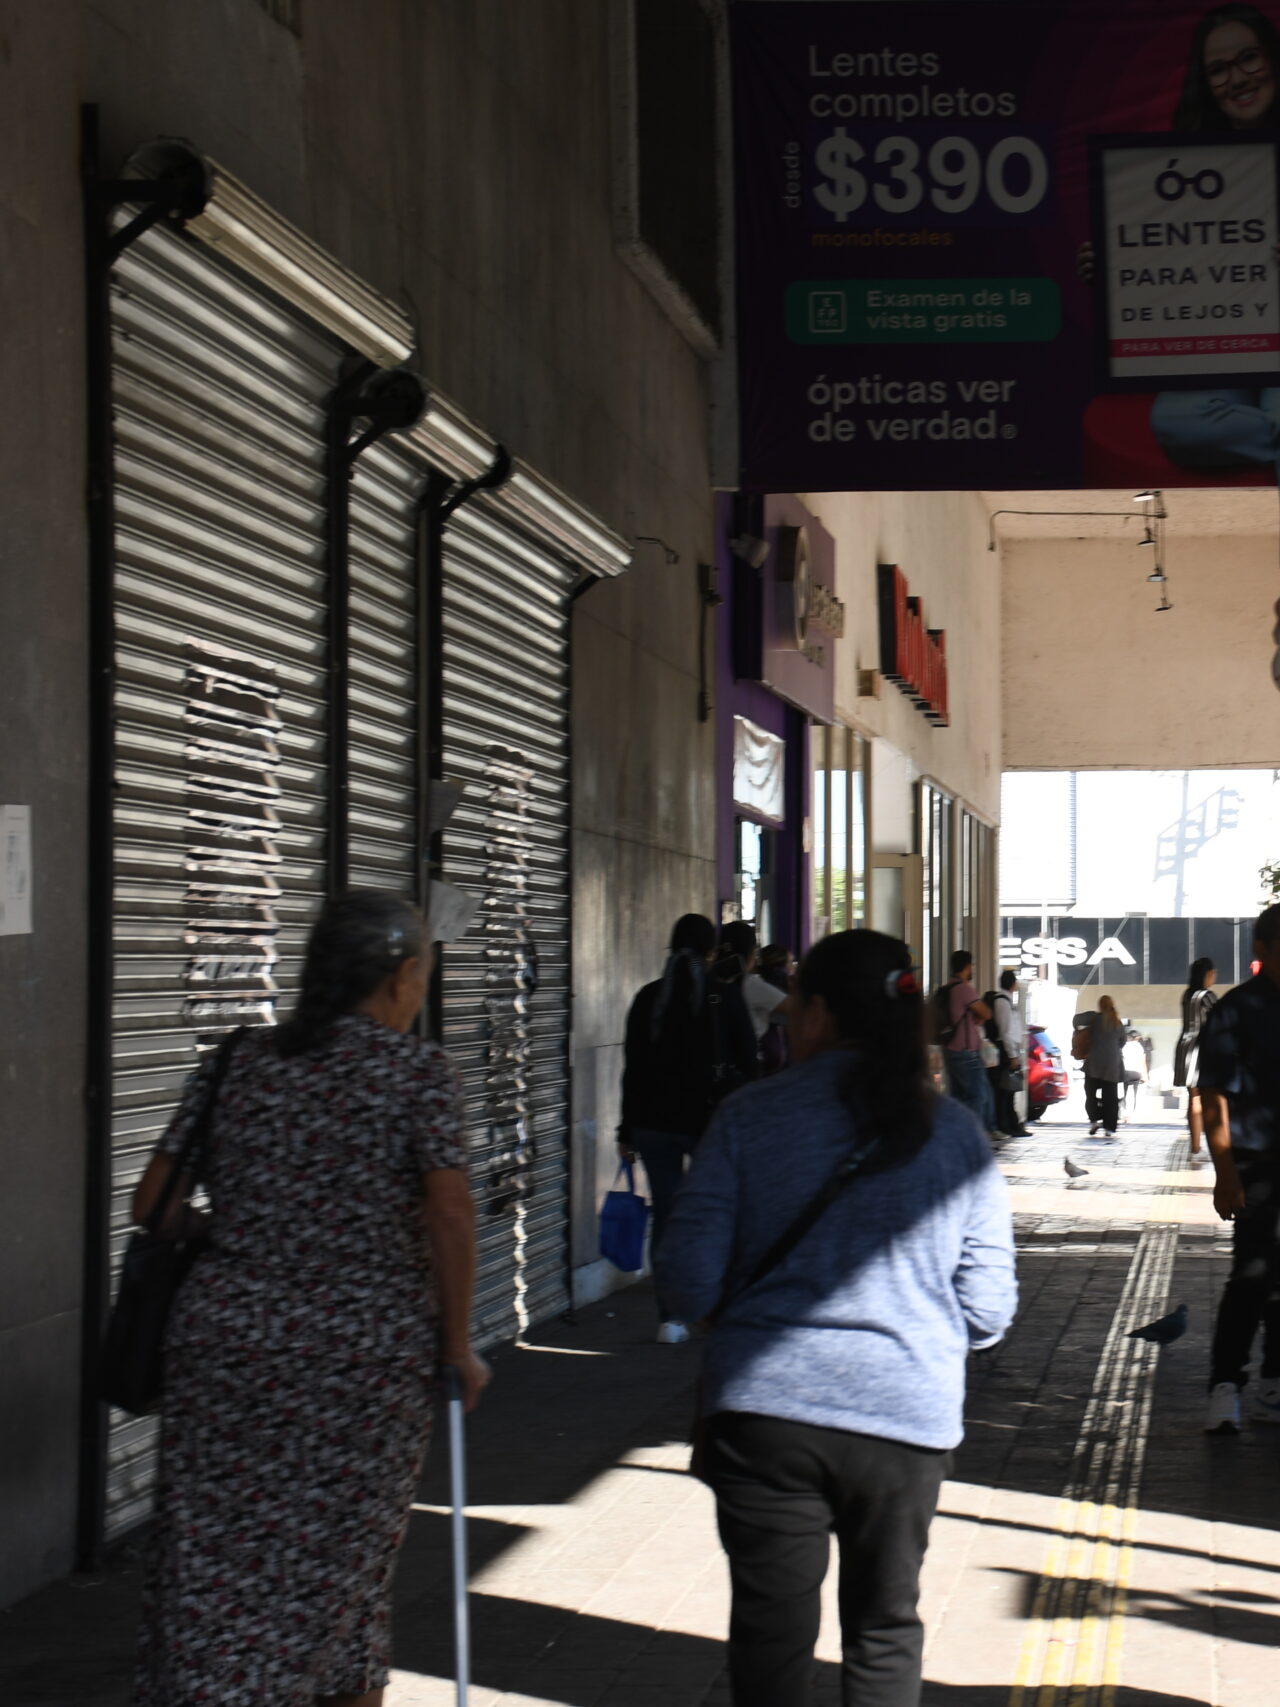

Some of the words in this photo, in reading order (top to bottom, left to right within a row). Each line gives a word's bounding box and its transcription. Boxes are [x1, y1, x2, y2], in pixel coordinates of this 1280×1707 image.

[808, 45, 940, 78] Lentes
[808, 85, 1017, 123] completos
[812, 126, 1049, 222] $390
[811, 229, 954, 247] monofocales
[1118, 219, 1266, 248] LENTES
[1120, 267, 1198, 287] PARA
[1208, 264, 1268, 283] VER
[867, 290, 966, 308] Examen
[973, 288, 1002, 307] de
[1009, 288, 1032, 307] la
[866, 312, 927, 330] vista
[934, 310, 1008, 334] gratis
[1121, 307, 1153, 322] DE
[1163, 304, 1244, 321] LEJOS
[1254, 302, 1269, 317] Y
[1121, 342, 1160, 353] PARA
[1164, 341, 1193, 352] VER
[1197, 340, 1217, 351] DE
[1219, 338, 1270, 350] CERCA
[808, 375, 946, 412] ópticas
[957, 379, 1017, 403] ver
[808, 413, 856, 443] de
